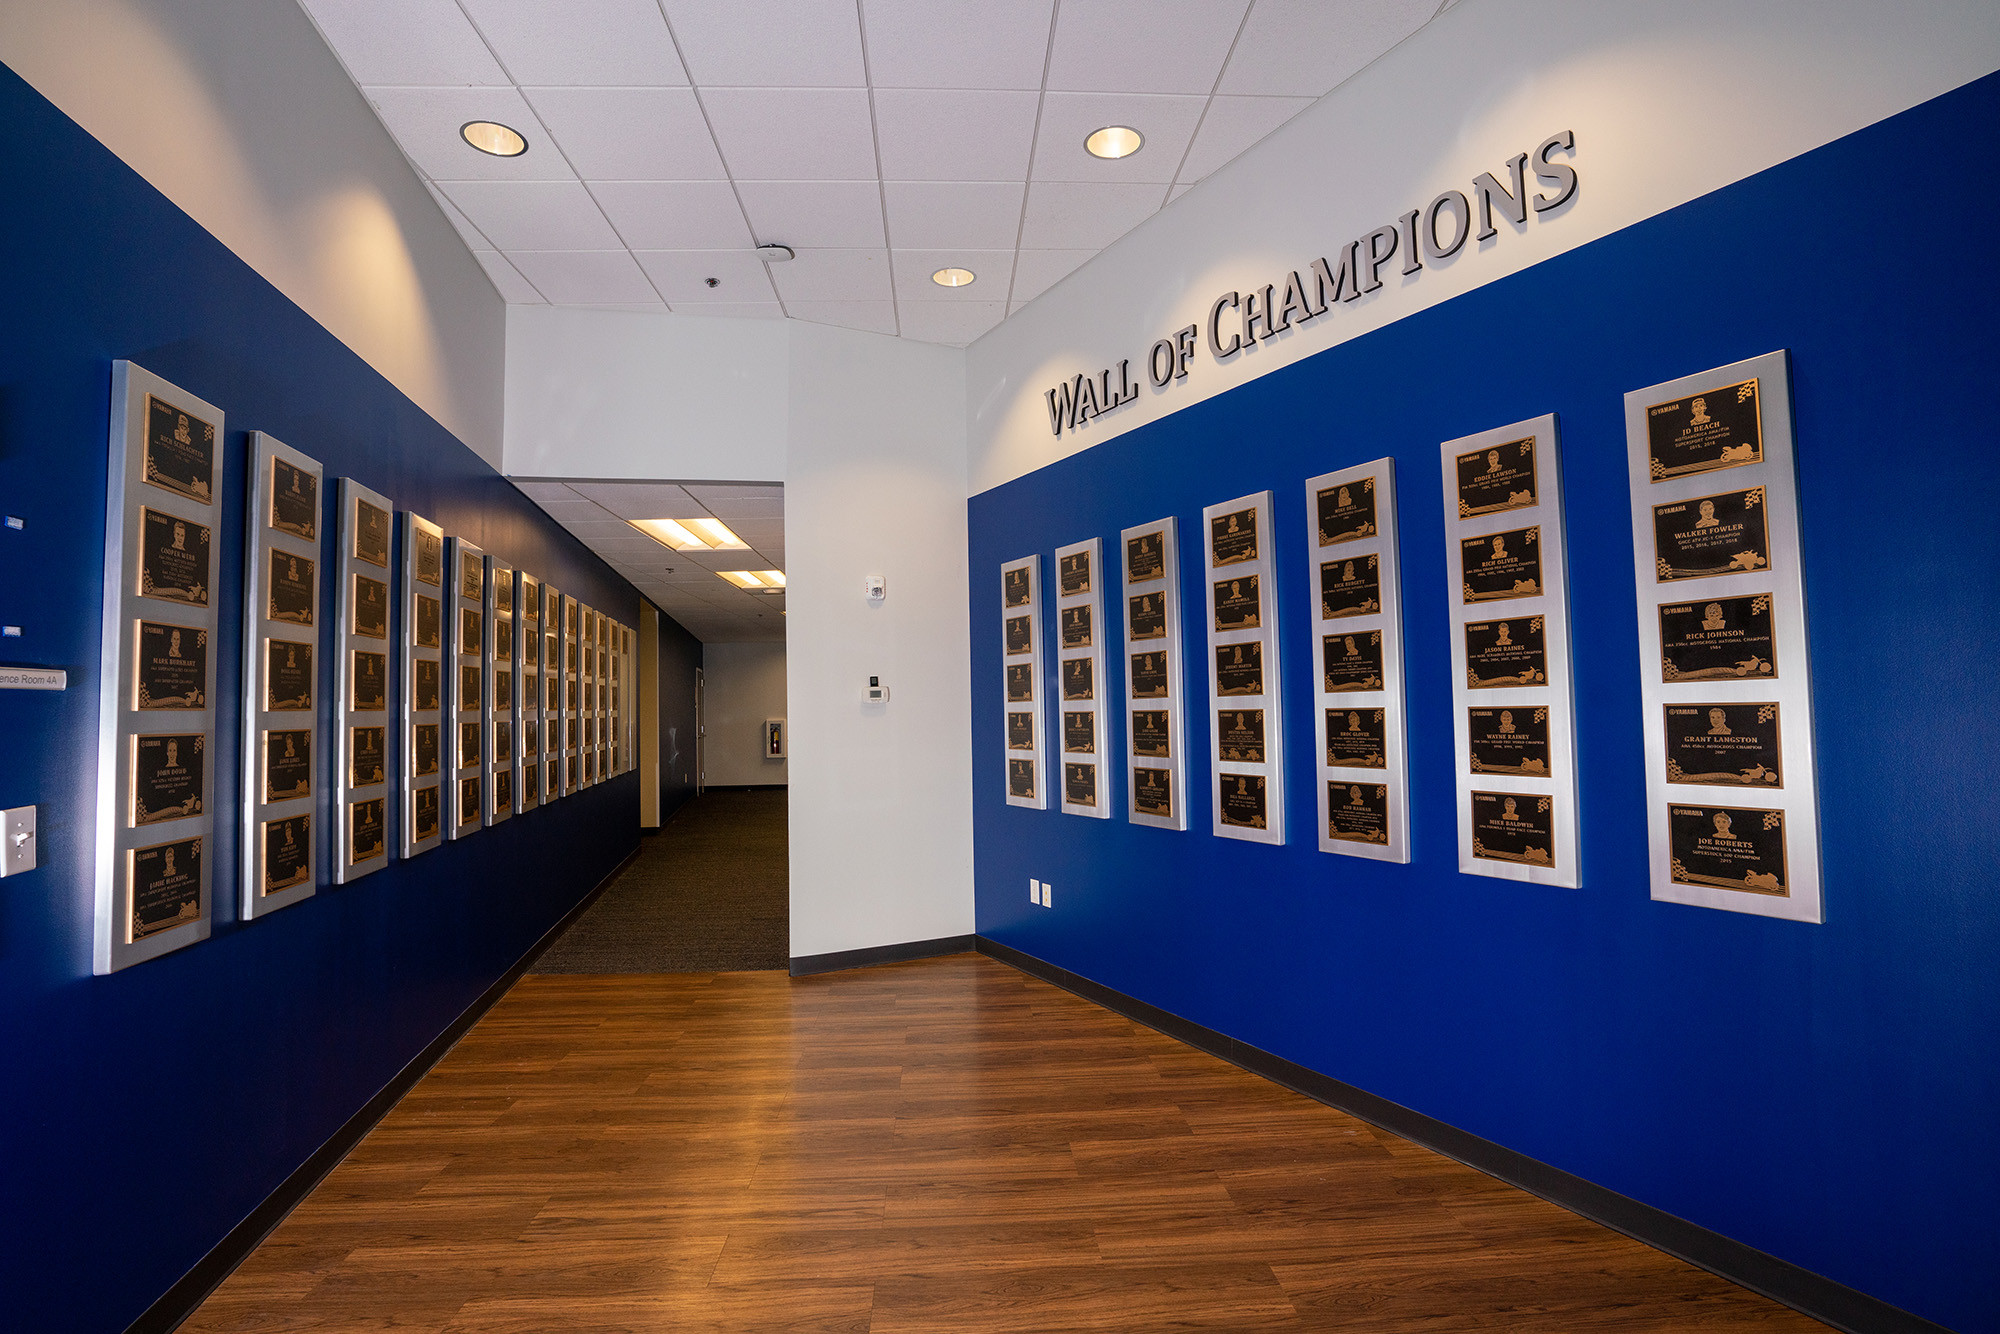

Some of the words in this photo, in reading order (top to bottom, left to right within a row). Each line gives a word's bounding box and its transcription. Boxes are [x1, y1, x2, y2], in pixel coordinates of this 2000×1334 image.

[1044, 358, 1138, 435] WALL
[1148, 324, 1197, 388] OF
[1206, 129, 1578, 358] CHAMPIONS
[1657, 404, 1679, 414] YAMAHA
[1682, 428, 1691, 436] JD
[1694, 421, 1720, 432] BEACH
[1705, 432, 1730, 441] CHAMPION
[1474, 474, 1491, 483] EDDIE
[1492, 468, 1516, 478] LAWSON
[1664, 505, 1686, 514] YAMAHA
[1674, 529, 1707, 539] WALKER
[1709, 523, 1744, 534] FOWLER
[161, 547, 181, 557] COOPER
[1497, 557, 1518, 565] OLIVER
[1707, 630, 1745, 639] JOHNSON
[0, 675, 19, 683] ence
[21, 674, 45, 684] Room
[47, 676, 57, 684] 4A
[1714, 839, 1753, 849] ROBERTS
